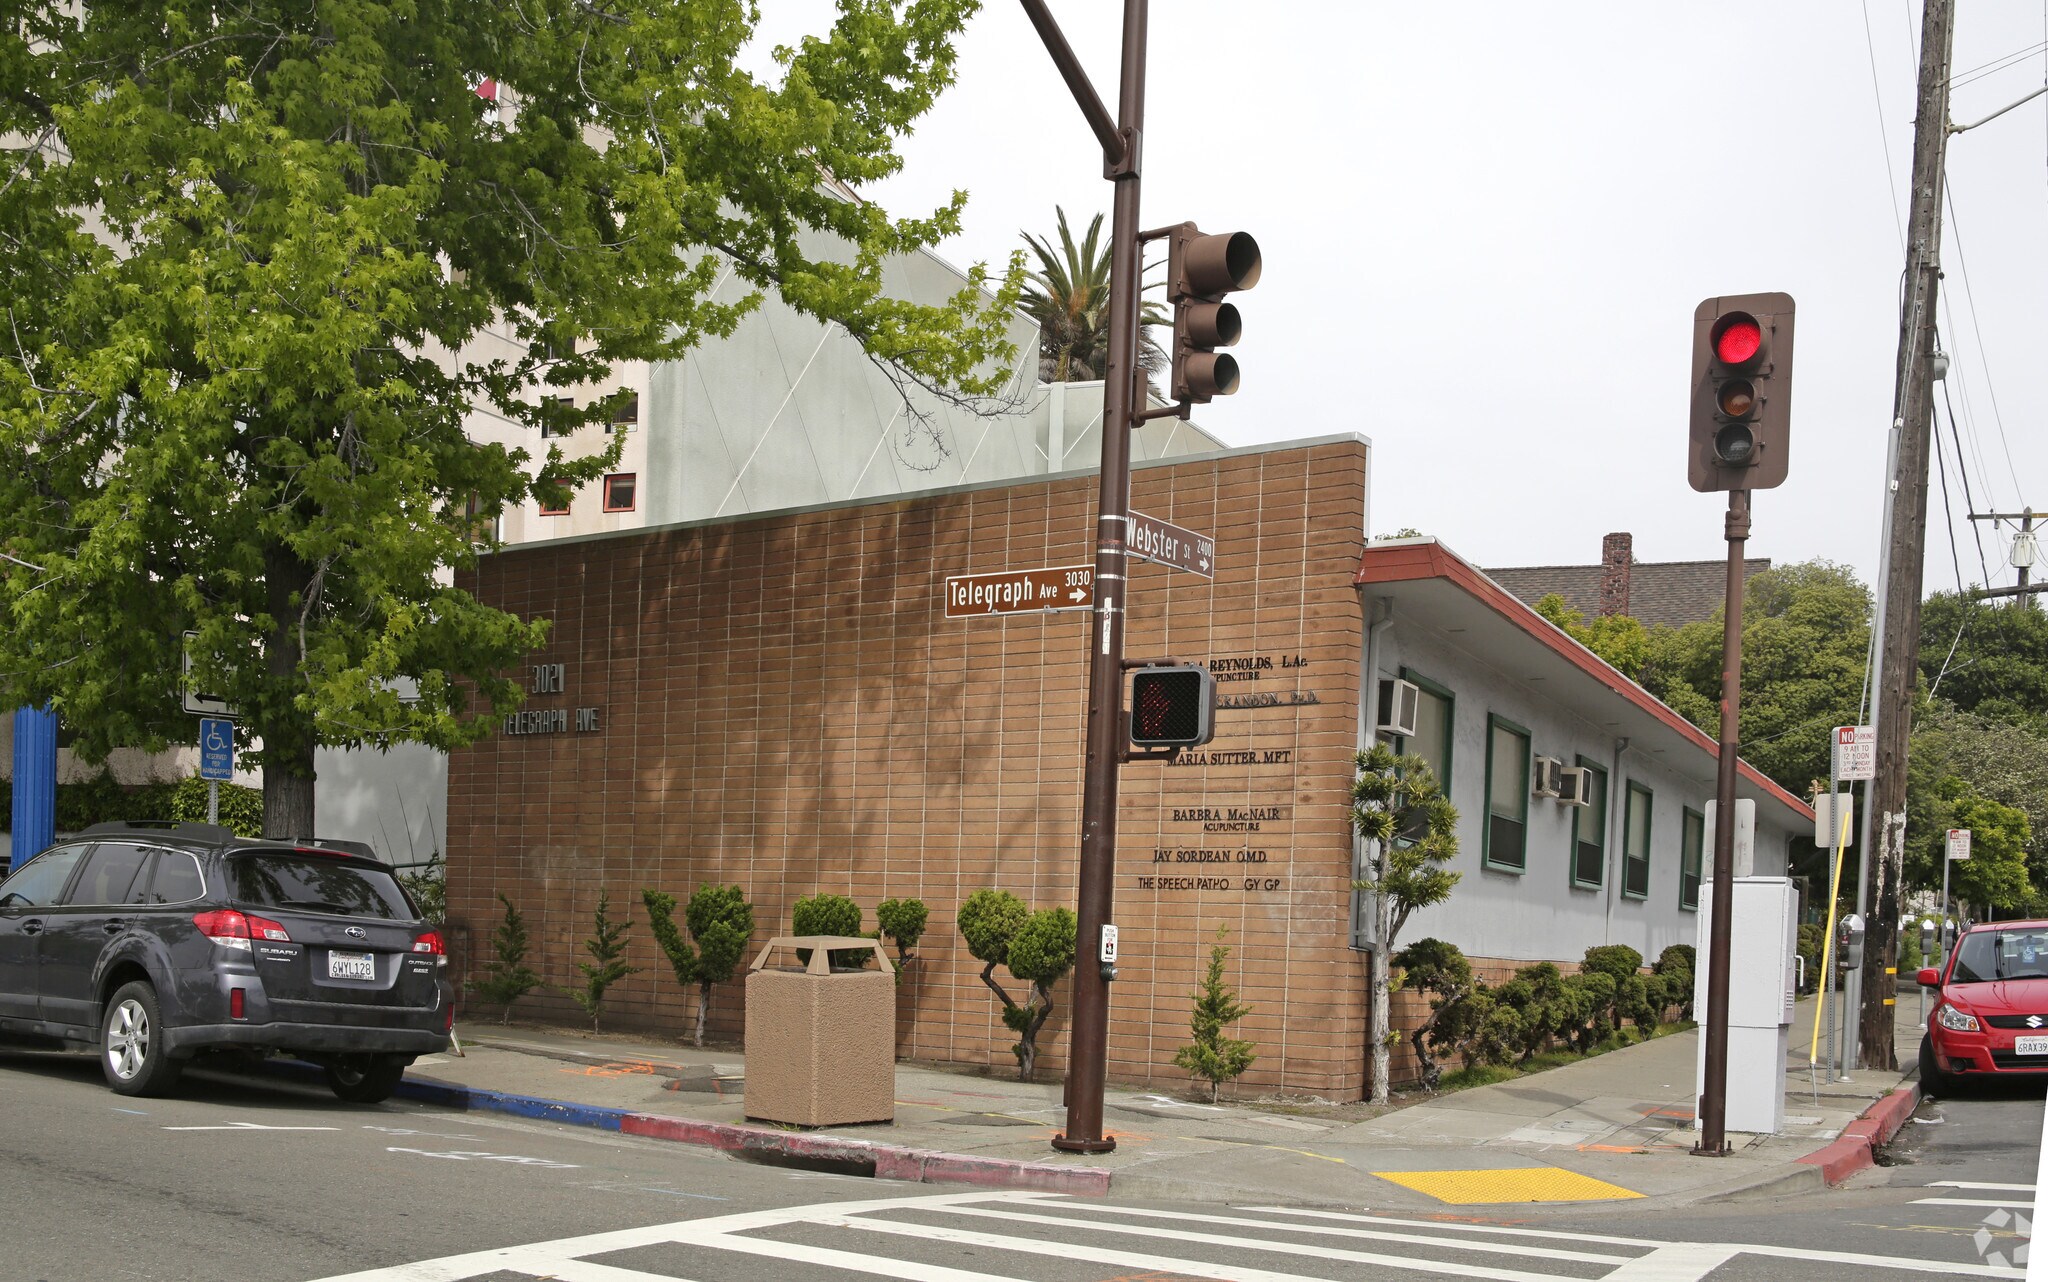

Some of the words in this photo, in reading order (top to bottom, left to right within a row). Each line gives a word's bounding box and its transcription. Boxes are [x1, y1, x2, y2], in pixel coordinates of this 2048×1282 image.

[1127, 517, 1178, 561] Webster
[1184, 544, 1190, 559] St
[1197, 539, 1212, 558] 2400
[951, 576, 1033, 612] Telegraph
[1040, 584, 1058, 599] Ave
[1065, 570, 1090, 587] 3030
[1210, 656, 1273, 673] REYNOLDS,
[532, 663, 565, 694] 3021
[1211, 671, 1260, 682] PUNCTURE
[503, 709, 567, 735] TELEGRAPH
[576, 707, 600, 731] AVE
[1841, 731, 1854, 743] NO
[1861, 744, 1870, 752] TO
[1263, 750, 1291, 764] MFT
[1173, 809, 1221, 821] BARBRA
[1204, 822, 1259, 831] ACUPUNCTURE
[1152, 849, 1172, 863] JAY
[1176, 850, 1231, 863] SORDEAN
[1138, 877, 1154, 889] THE
[1157, 877, 1194, 890] SPEECH
[1244, 878, 1260, 891] GY
[1264, 878, 1281, 891] GP
[260, 947, 298, 956] SUBARU
[332, 961, 371, 975] 6WYL128
